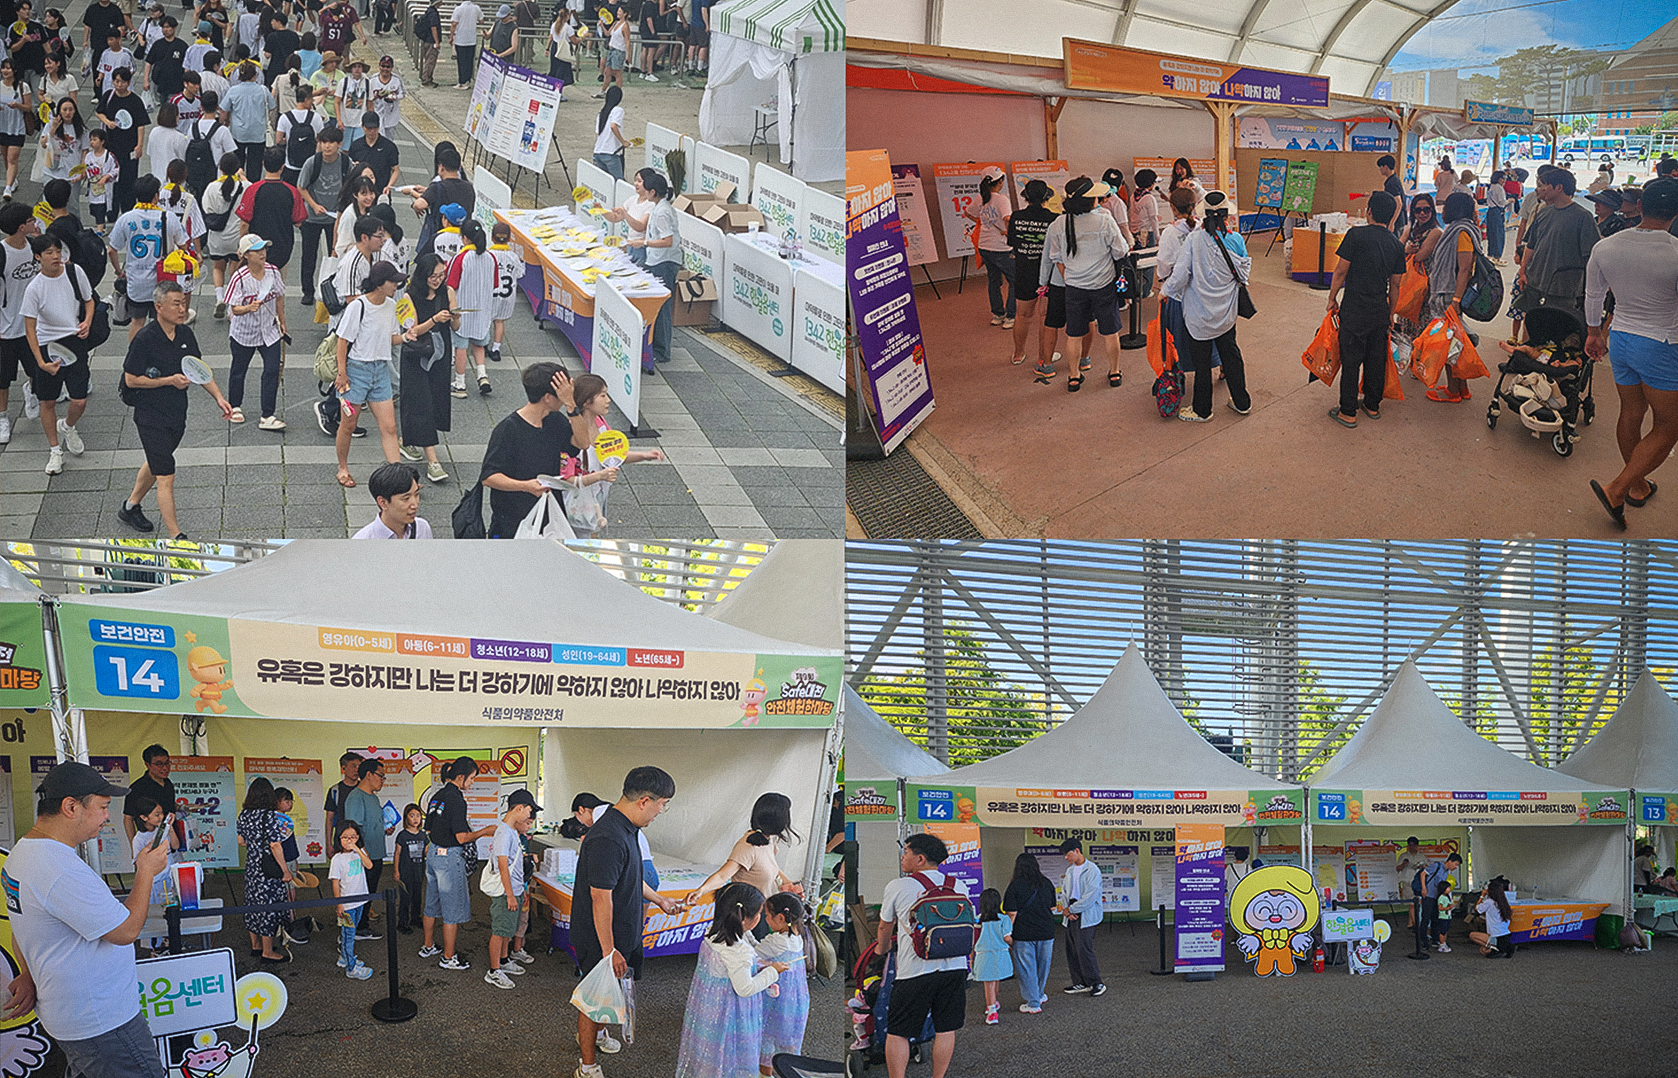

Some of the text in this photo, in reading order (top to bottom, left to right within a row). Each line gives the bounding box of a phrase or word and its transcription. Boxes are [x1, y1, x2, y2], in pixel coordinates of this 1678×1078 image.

[1162, 75, 1281, 101] 약하지 않아 나약하지 않아
[873, 181, 892, 203] 않아
[880, 197, 895, 219] 않아
[809, 224, 826, 242] 1342
[130, 234, 162, 259] 67
[493, 275, 514, 298] 3
[733, 277, 749, 299] 1342
[805, 317, 825, 342] 1342
[100, 624, 166, 644] 보건안전
[323, 632, 680, 666] 영유아(0~5세) 아동(6~11세) 청소년(12~18세) 성인(19~64세) 노년(65세~)
[109, 656, 165, 693] 14
[257, 658, 741, 701] 유혹은 강하지만 나는 더 강하기에 약하지 않아 나약하지 않아
[781, 682, 826, 699] Safe대전
[482, 707, 564, 722] 식품의약품안전처
[766, 699, 834, 716] 안전체험한마당
[925, 804, 947, 818] 14
[987, 802, 1242, 815] 유혹은 강하지만 나는 더 강하기에 약하지 않아 나약하지 않아
[1322, 805, 1341, 818] 14
[1371, 803, 1577, 814] 유혹은 강하지만 나는 더 강하기에 약하지 않아 나약하지 않아
[1648, 808, 1660, 819] 13
[1102, 830, 1151, 842] 나약하지
